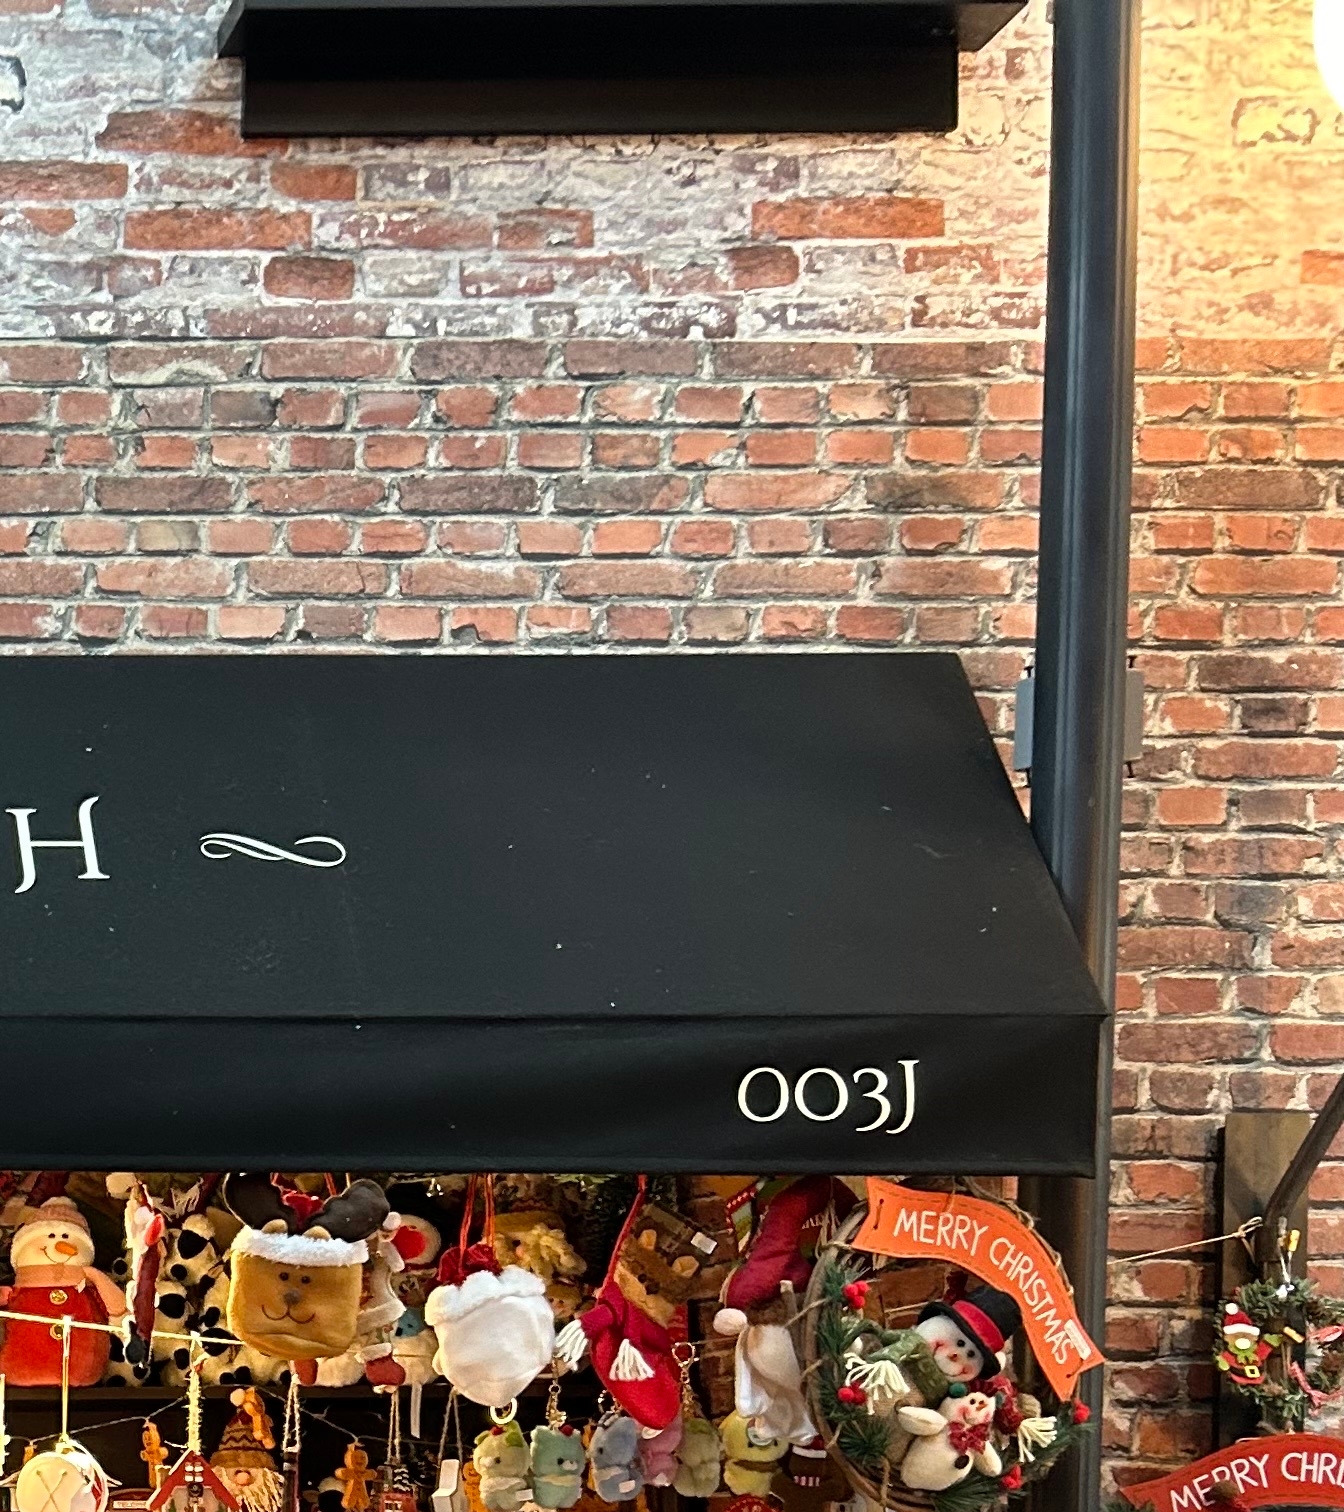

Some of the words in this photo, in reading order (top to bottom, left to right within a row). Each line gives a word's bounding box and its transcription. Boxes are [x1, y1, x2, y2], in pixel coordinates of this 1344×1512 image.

[6, 796, 111, 894] H
[893, 1207, 989, 1257] MERRY
[988, 1236, 1076, 1365] CHRISTMAS
